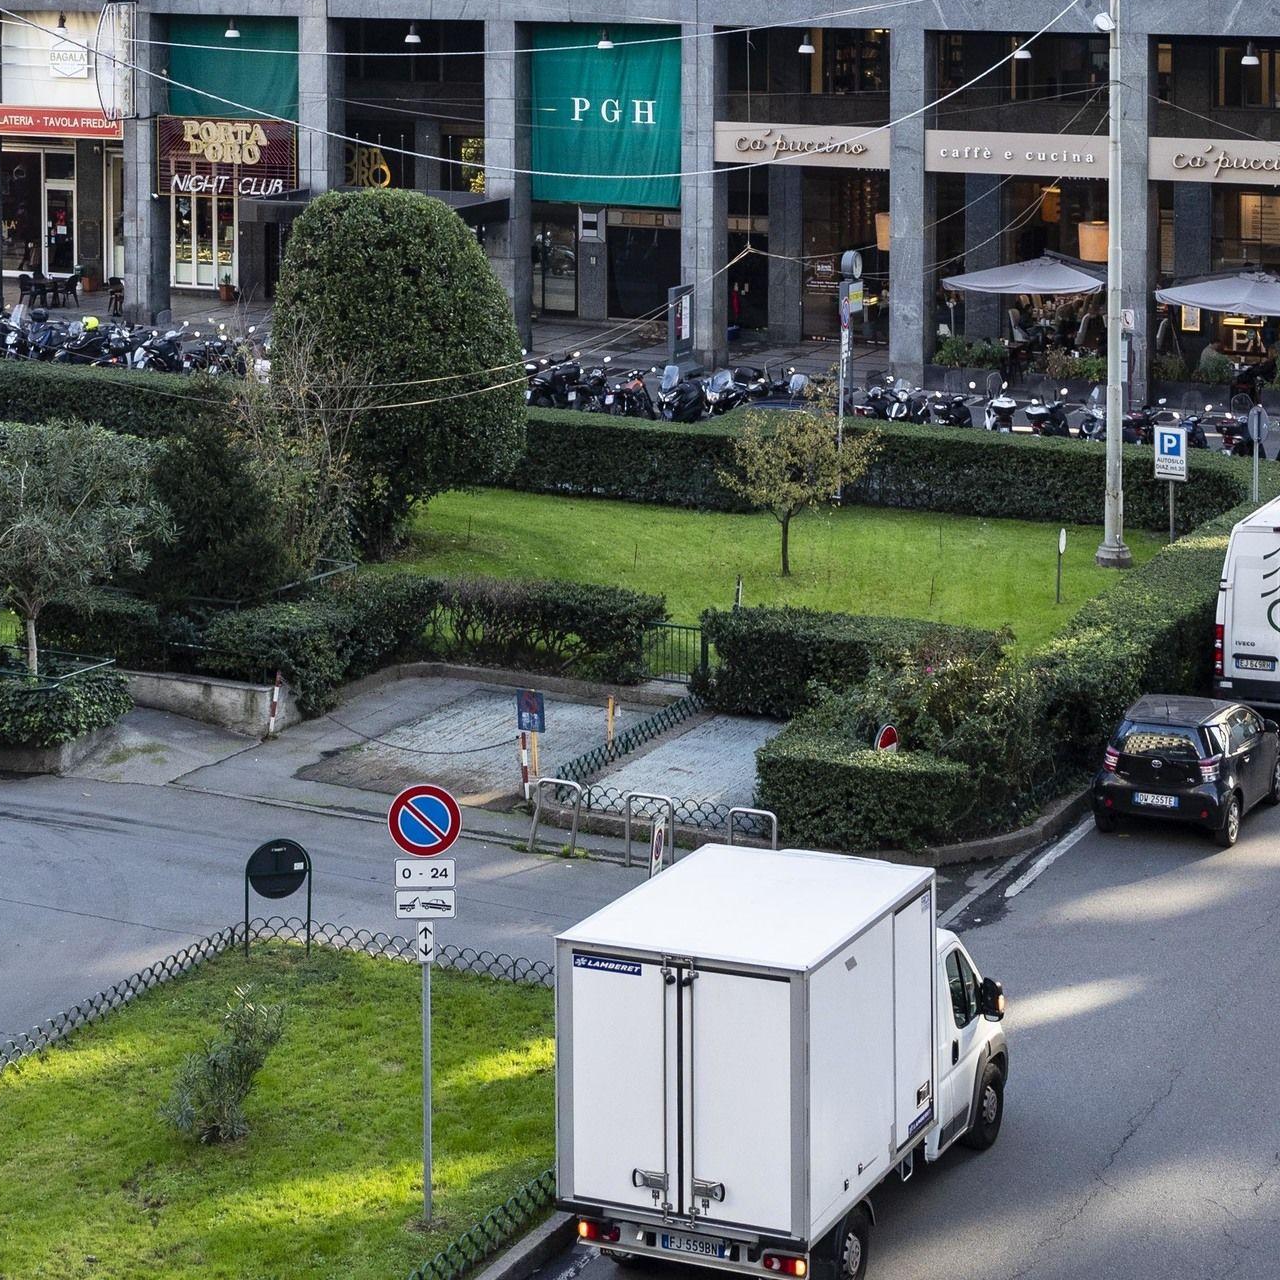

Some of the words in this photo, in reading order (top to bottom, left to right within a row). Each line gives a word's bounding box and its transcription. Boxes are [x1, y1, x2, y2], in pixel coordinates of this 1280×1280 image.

[49, 52, 87, 62] BAGALA'
[43, 116, 79, 127] TAVOLA
[81, 118, 118, 129] FREDDA
[182, 120, 268, 147] PORTA
[190, 140, 261, 165] D'ORO
[940, 147, 992, 160] caffè
[1004, 150, 1013, 160] e
[1025, 150, 1095, 164] cucina
[170, 174, 229, 193] NIGHT
[238, 177, 283, 196] CLUB
[1163, 435, 1176, 453] P
[1157, 457, 1184, 465] AUTOSILO
[402, 868, 411, 879] 0
[431, 868, 448, 878] 24
[588, 960, 640, 973] LAMBERET
[669, 1236, 682, 1248] FJ
[685, 1240, 718, 1256] 559BN
